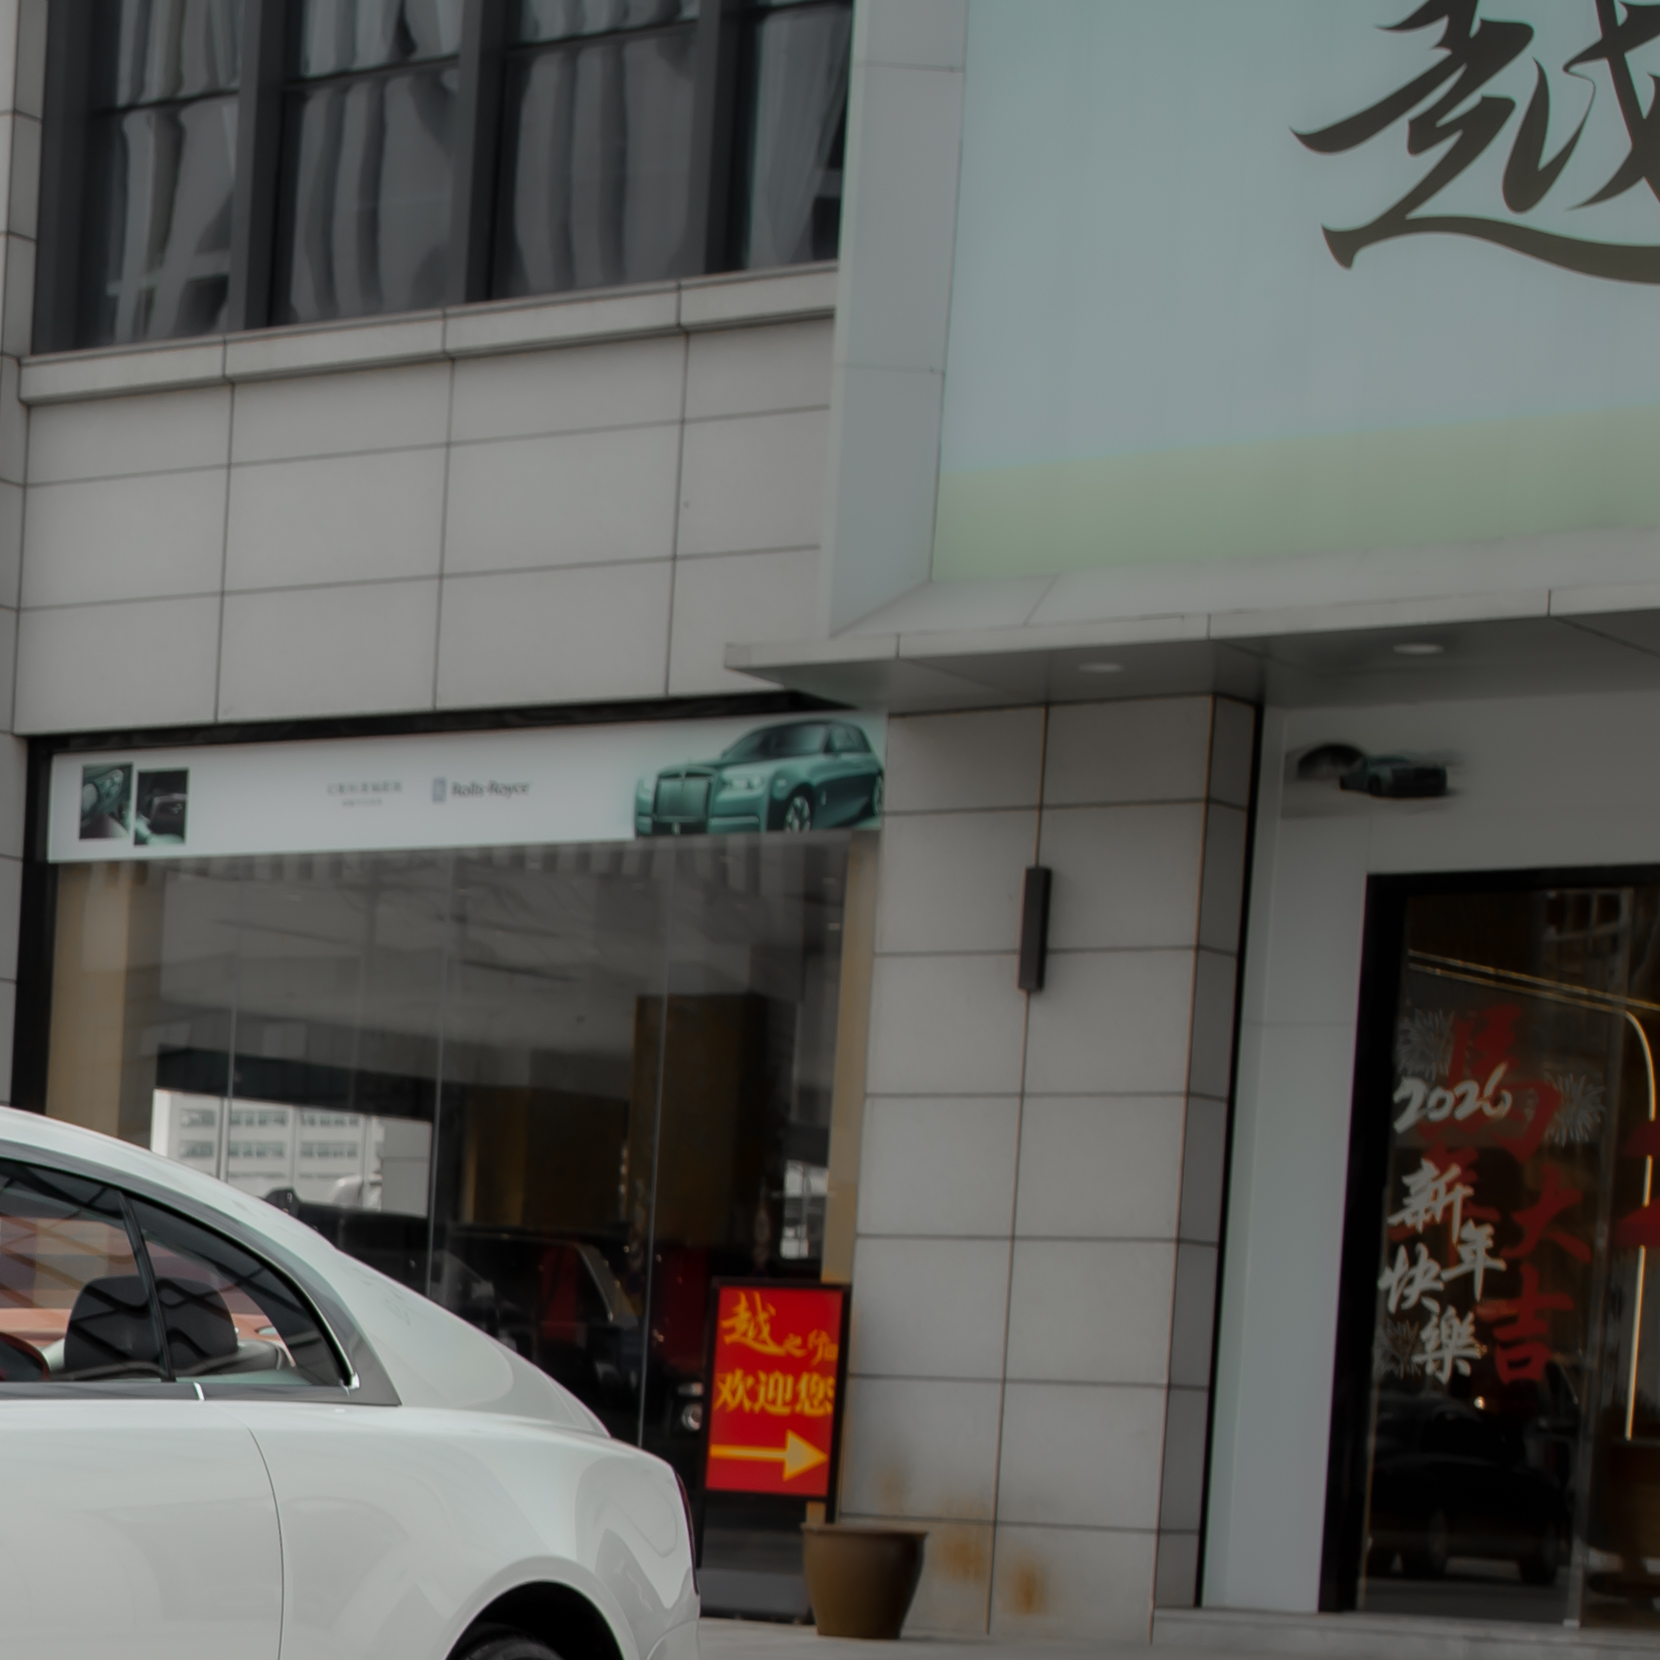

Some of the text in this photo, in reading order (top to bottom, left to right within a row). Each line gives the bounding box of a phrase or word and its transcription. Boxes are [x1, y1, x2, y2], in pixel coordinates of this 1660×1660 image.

[1393, 1062, 1512, 1133] 2026
[714, 1368, 837, 1418] 欢迎您
